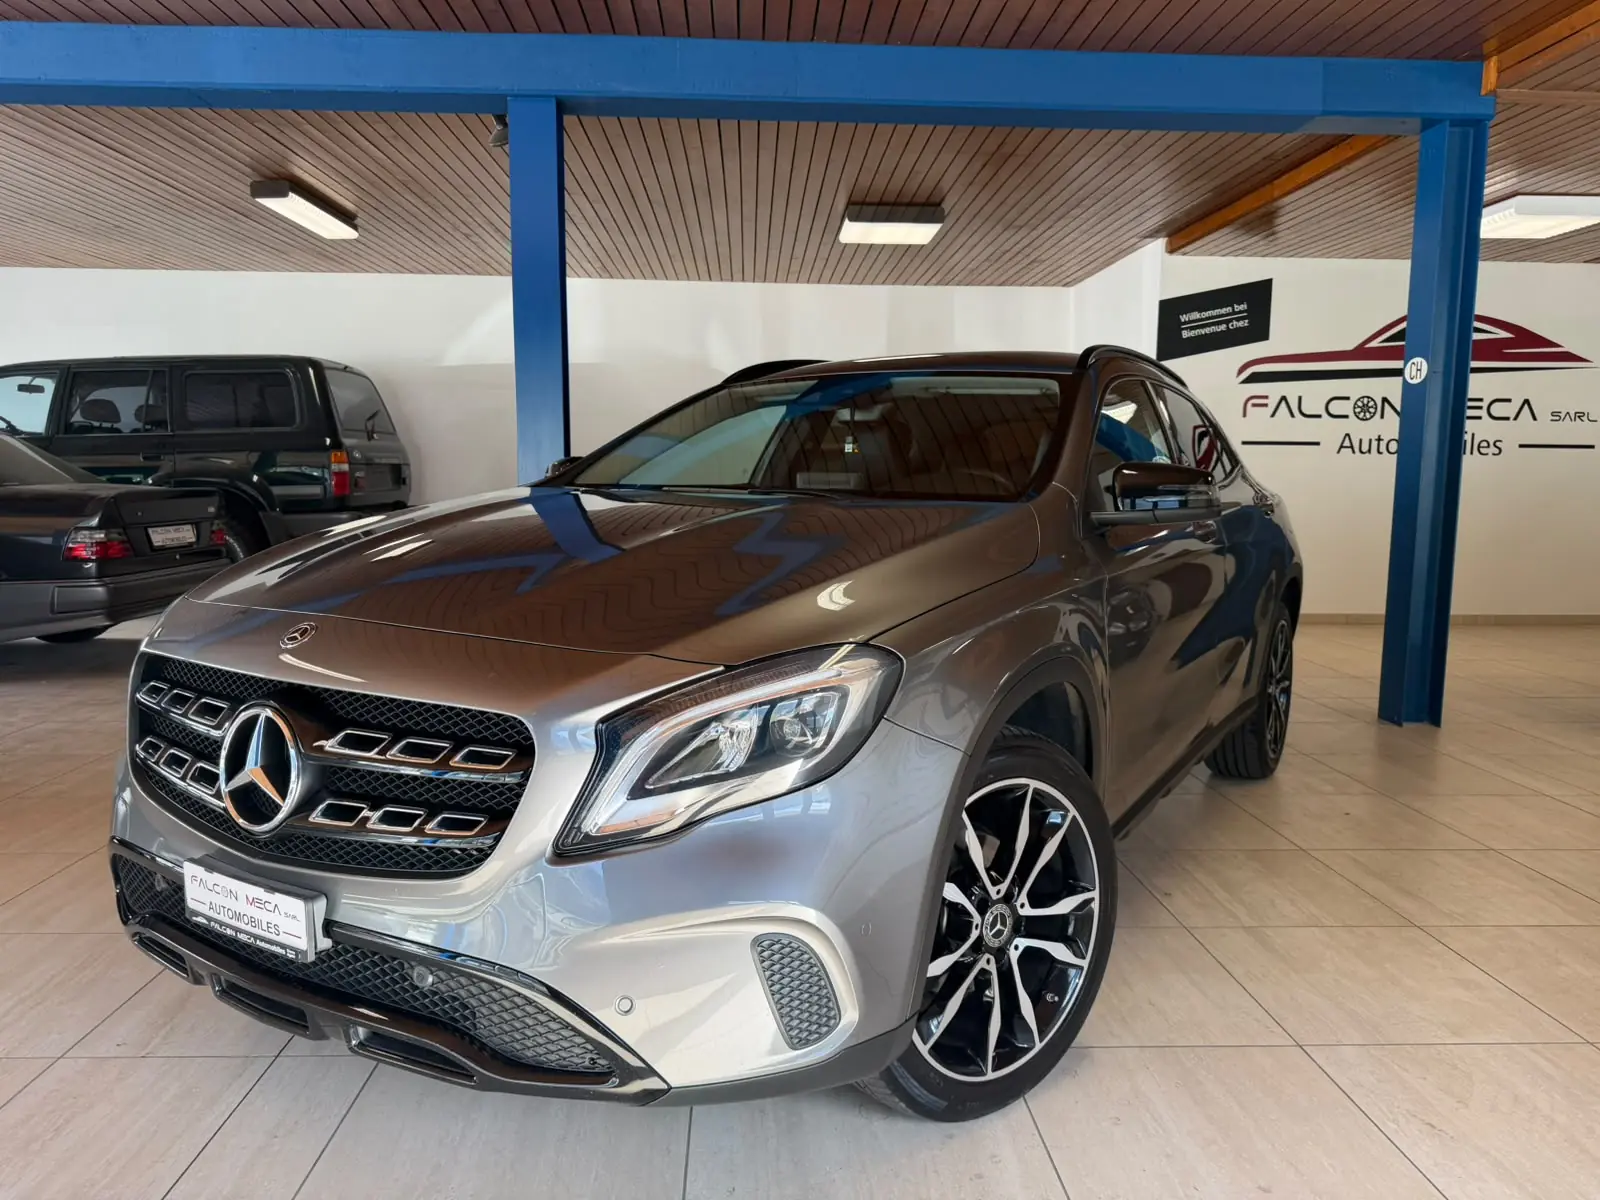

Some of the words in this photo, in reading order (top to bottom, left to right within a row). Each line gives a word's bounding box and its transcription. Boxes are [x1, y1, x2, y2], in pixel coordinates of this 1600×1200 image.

[1179, 306, 1233, 322] Willkommen
[1233, 302, 1248, 312] bei
[1181, 323, 1227, 339] Bienvenue
[1228, 319, 1249, 329] chez
[1409, 361, 1423, 380] CH
[1242, 395, 1400, 421] FALCON
[1466, 398, 1538, 422] ECA
[1550, 411, 1598, 423] SARL
[190, 874, 239, 902] FALCON
[245, 894, 282, 916] MECA
[208, 901, 281, 937] AUTOMOBILES
